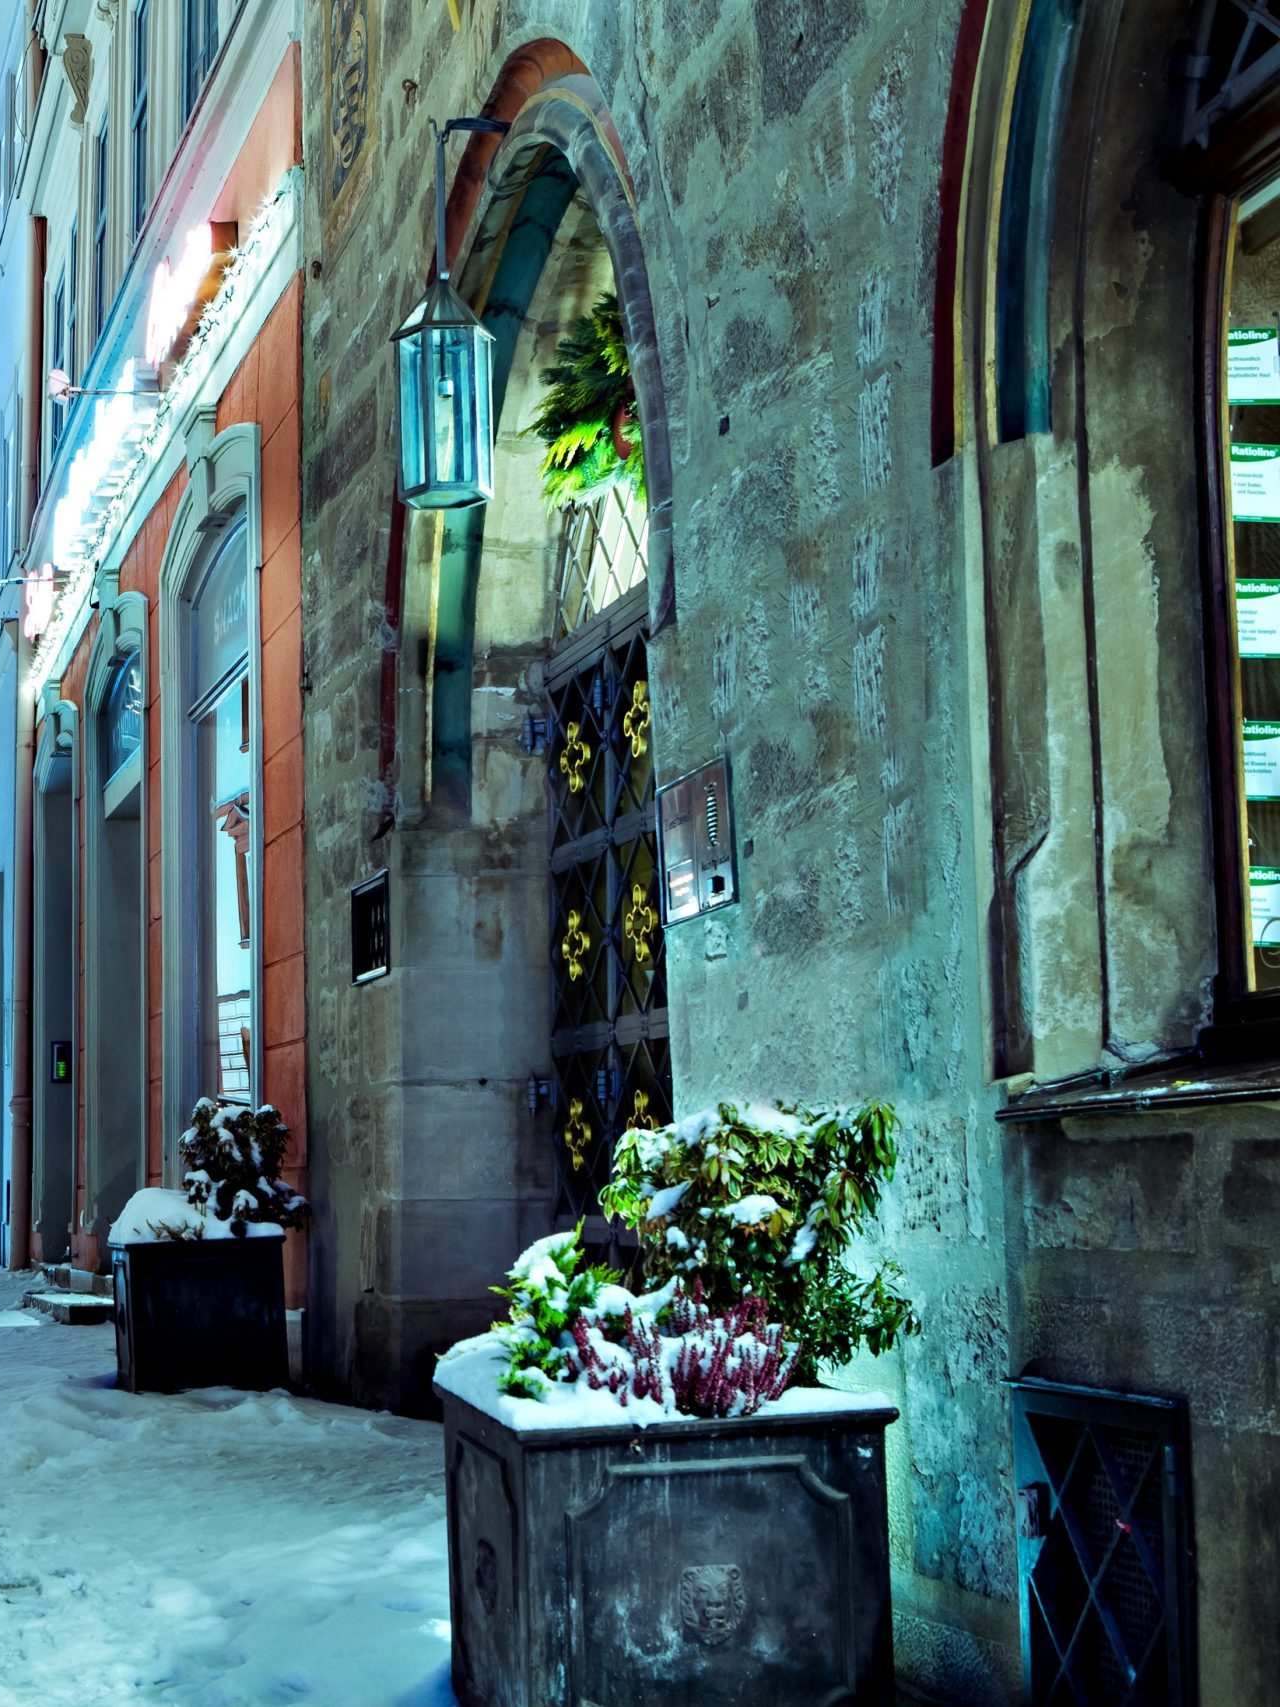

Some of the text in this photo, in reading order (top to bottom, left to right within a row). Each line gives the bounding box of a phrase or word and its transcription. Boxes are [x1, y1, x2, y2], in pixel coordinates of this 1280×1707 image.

[1228, 330, 1269, 340] atioline
[1231, 445, 1276, 457] Ratioline
[1235, 582, 1279, 593] Ratioline
